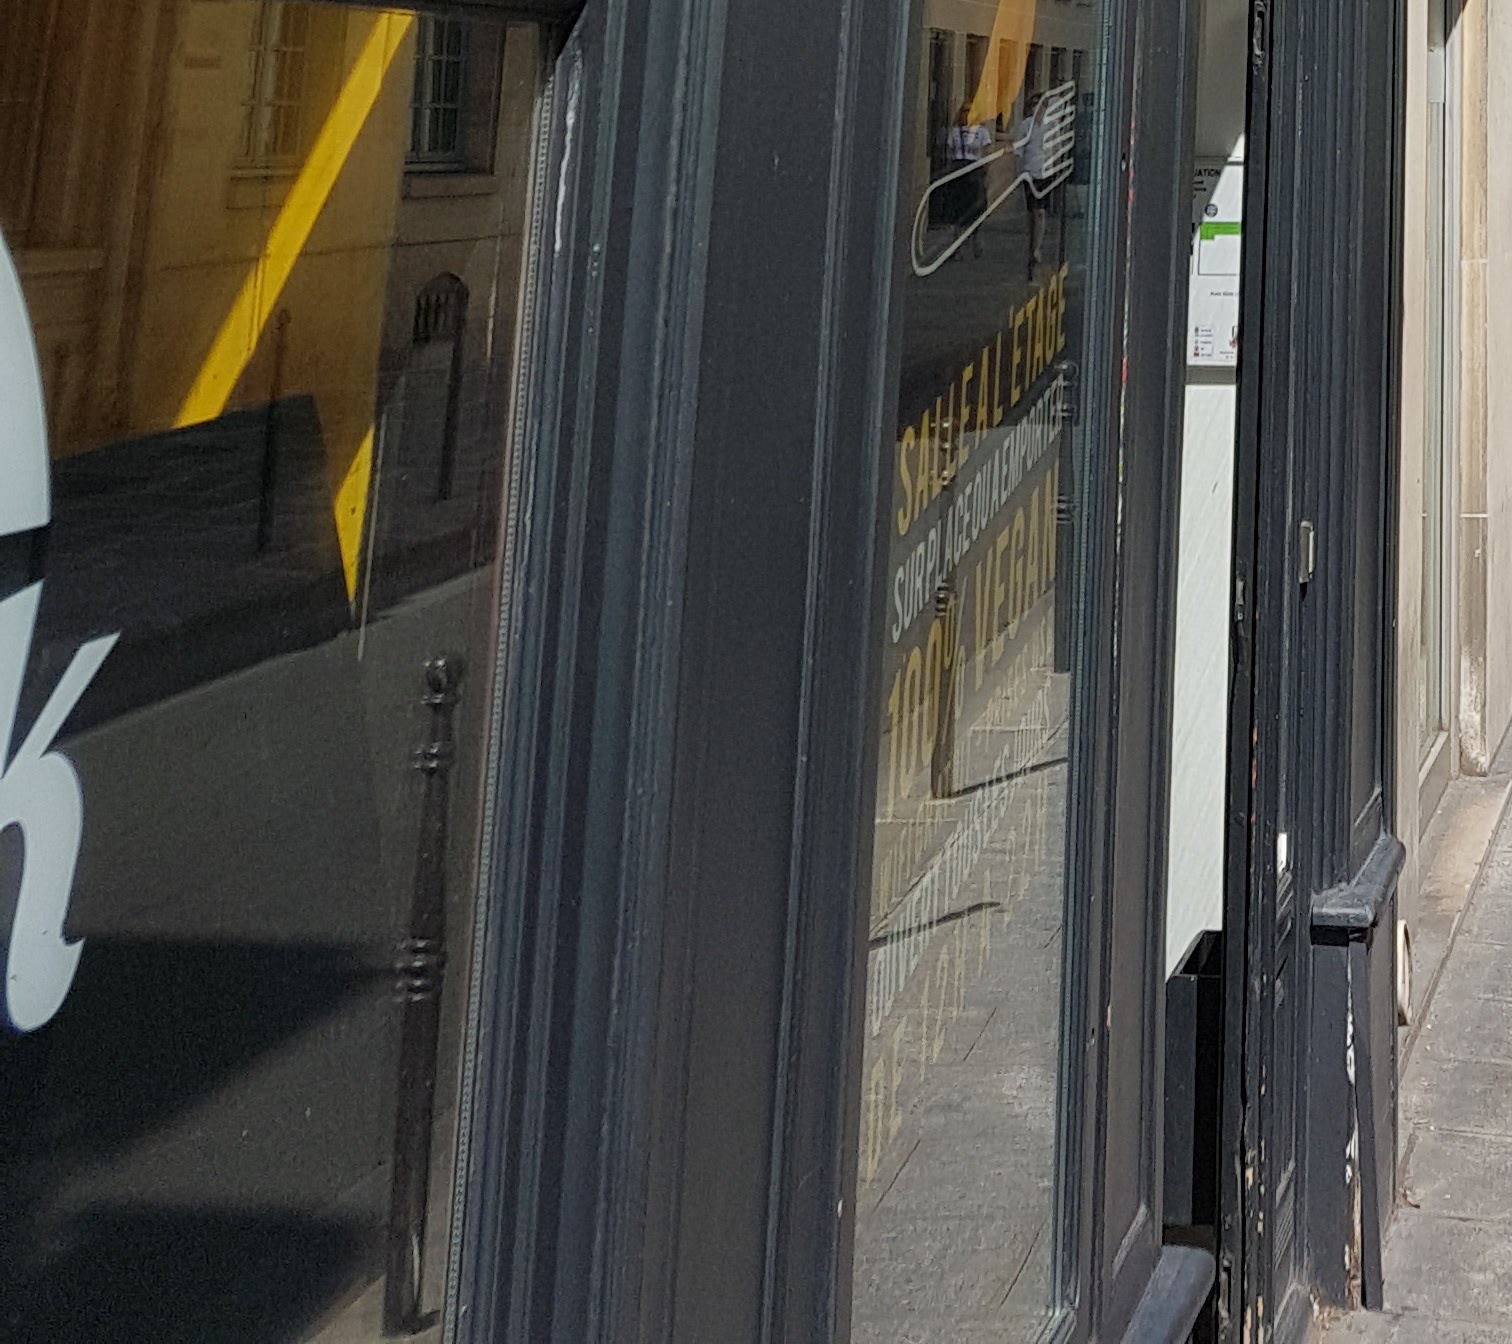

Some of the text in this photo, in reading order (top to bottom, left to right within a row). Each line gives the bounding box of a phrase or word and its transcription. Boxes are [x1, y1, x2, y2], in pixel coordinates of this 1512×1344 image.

[898, 363, 973, 535] SALLE
[887, 467, 1058, 820] 100% VEGAN
[893, 539, 924, 644] SUR
[925, 485, 972, 601] PLACE
